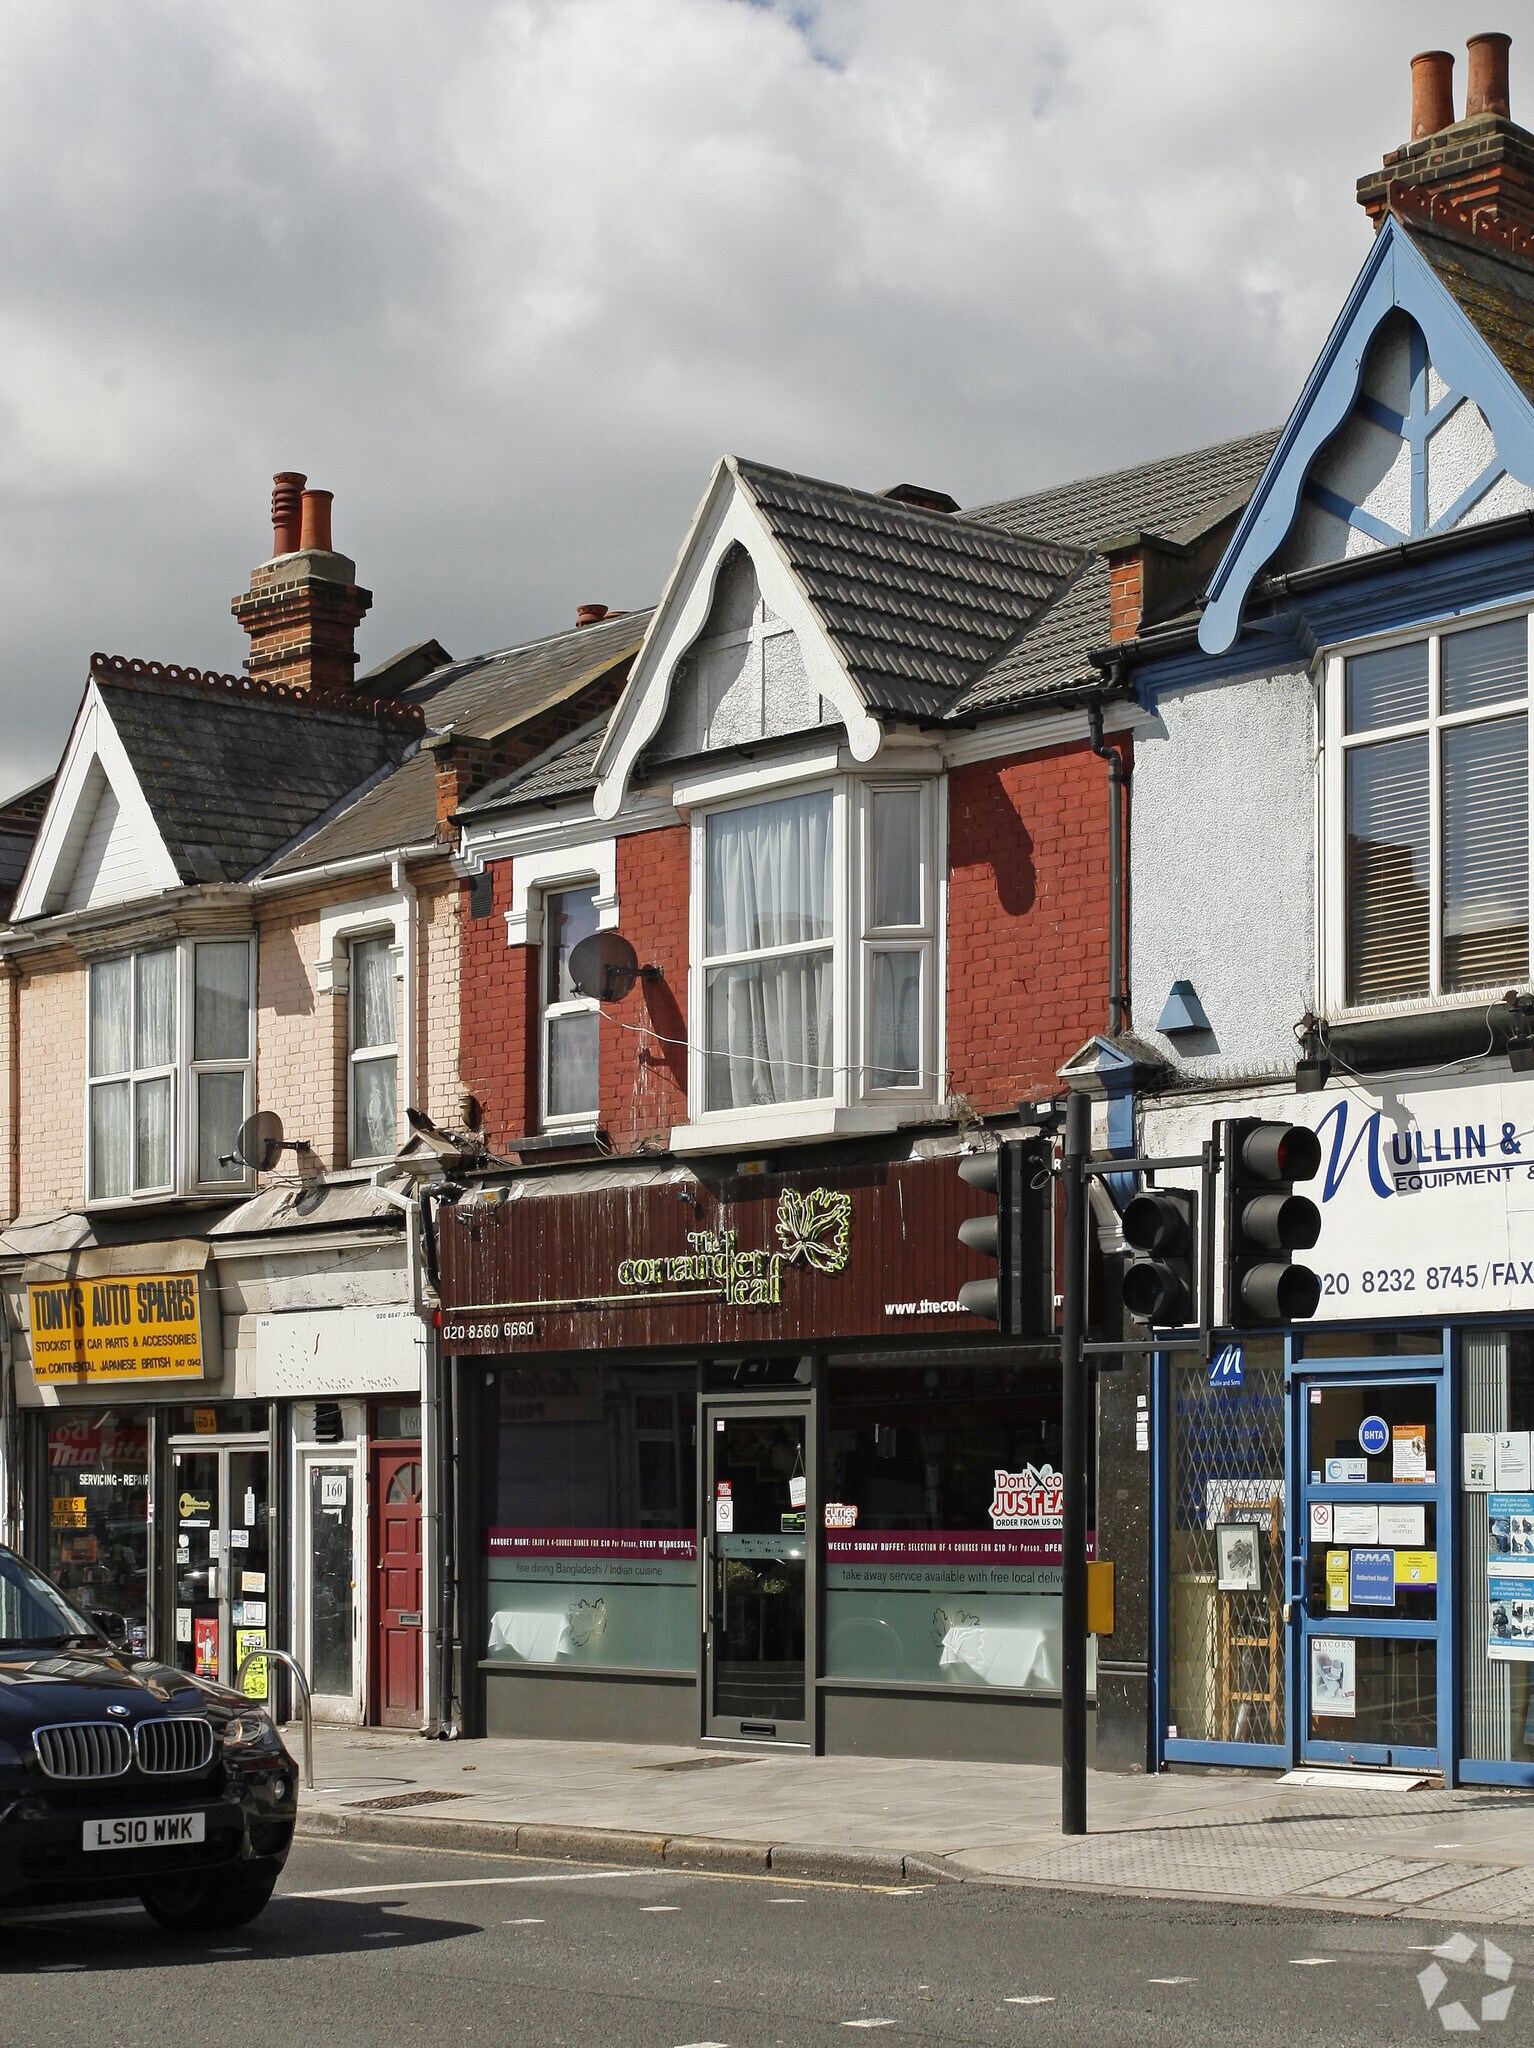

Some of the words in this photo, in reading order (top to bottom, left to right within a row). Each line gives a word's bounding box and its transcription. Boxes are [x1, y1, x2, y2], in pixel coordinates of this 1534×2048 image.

[1499, 1122, 1522, 1155] &
[1395, 1167, 1514, 1192] EQUIPMENT
[687, 1230, 721, 1253] The
[1361, 1268, 1416, 1293] 8232
[92, 1283, 131, 1327] AUTO
[136, 1278, 195, 1323] SPARES
[443, 1325, 465, 1339] 020
[503, 1321, 534, 1336] 6660
[35, 1339, 72, 1353] STOCKIST
[74, 1338, 85, 1349] OF
[87, 1338, 103, 1349] CAR
[105, 1336, 129, 1349] PARTS
[133, 1336, 139, 1347] &
[142, 1333, 197, 1347] ACCESSORIES
[48, 1360, 97, 1375] CONTINENTAL
[100, 1358, 137, 1371] JAPANESE
[141, 1357, 171, 1370] BRITISH
[175, 1359, 185, 1368] 847
[405, 1416, 422, 1430] 160
[1364, 1430, 1384, 1440] BHTA
[1348, 1462, 1364, 1470] OFT
[79, 1473, 117, 1486] SERVICING
[997, 1472, 1032, 1488] Don't
[1045, 1475, 1063, 1487] co
[326, 1483, 343, 1498] 160
[58, 1500, 79, 1511] KEYS
[992, 1491, 1041, 1515] JUST
[825, 1507, 857, 1517] curries
[68, 1513, 86, 1526] HERE
[995, 1518, 1019, 1527] ORDER
[1020, 1518, 1040, 1526] FROM
[1041, 1518, 1051, 1526] US
[490, 1537, 513, 1546] BANQUET
[639, 1540, 656, 1548] EVERY
[827, 1542, 852, 1551] WEEKLY
[854, 1542, 878, 1551] SUNDAY
[880, 1542, 906, 1551] BUFFET:
[908, 1542, 937, 1552] SELECTION
[939, 1543, 946, 1552] OF
[954, 1543, 979, 1552] COURSES
[980, 1543, 991, 1552] FOR
[993, 1543, 1006, 1552] £10
[1008, 1543, 1018, 1552] Per
[1044, 1543, 1063, 1553] OPEN
[1354, 1553, 1392, 1563] RMA
[516, 1562, 530, 1573] fine
[531, 1562, 554, 1576] dining
[556, 1562, 603, 1576] Bangladeshi
[609, 1563, 633, 1575] Indian
[634, 1565, 663, 1576] cuisine
[842, 1568, 861, 1581] take
[863, 1570, 888, 1584] away
[889, 1570, 922, 1582] service
[924, 1569, 965, 1582] available
[967, 1570, 988, 1582] with
[990, 1570, 1009, 1583] free
[1011, 1571, 1035, 1583] local
[1322, 1640, 1354, 1649] ACORN
[97, 1820, 148, 1846] LS10
[153, 1816, 194, 1841] WWK
